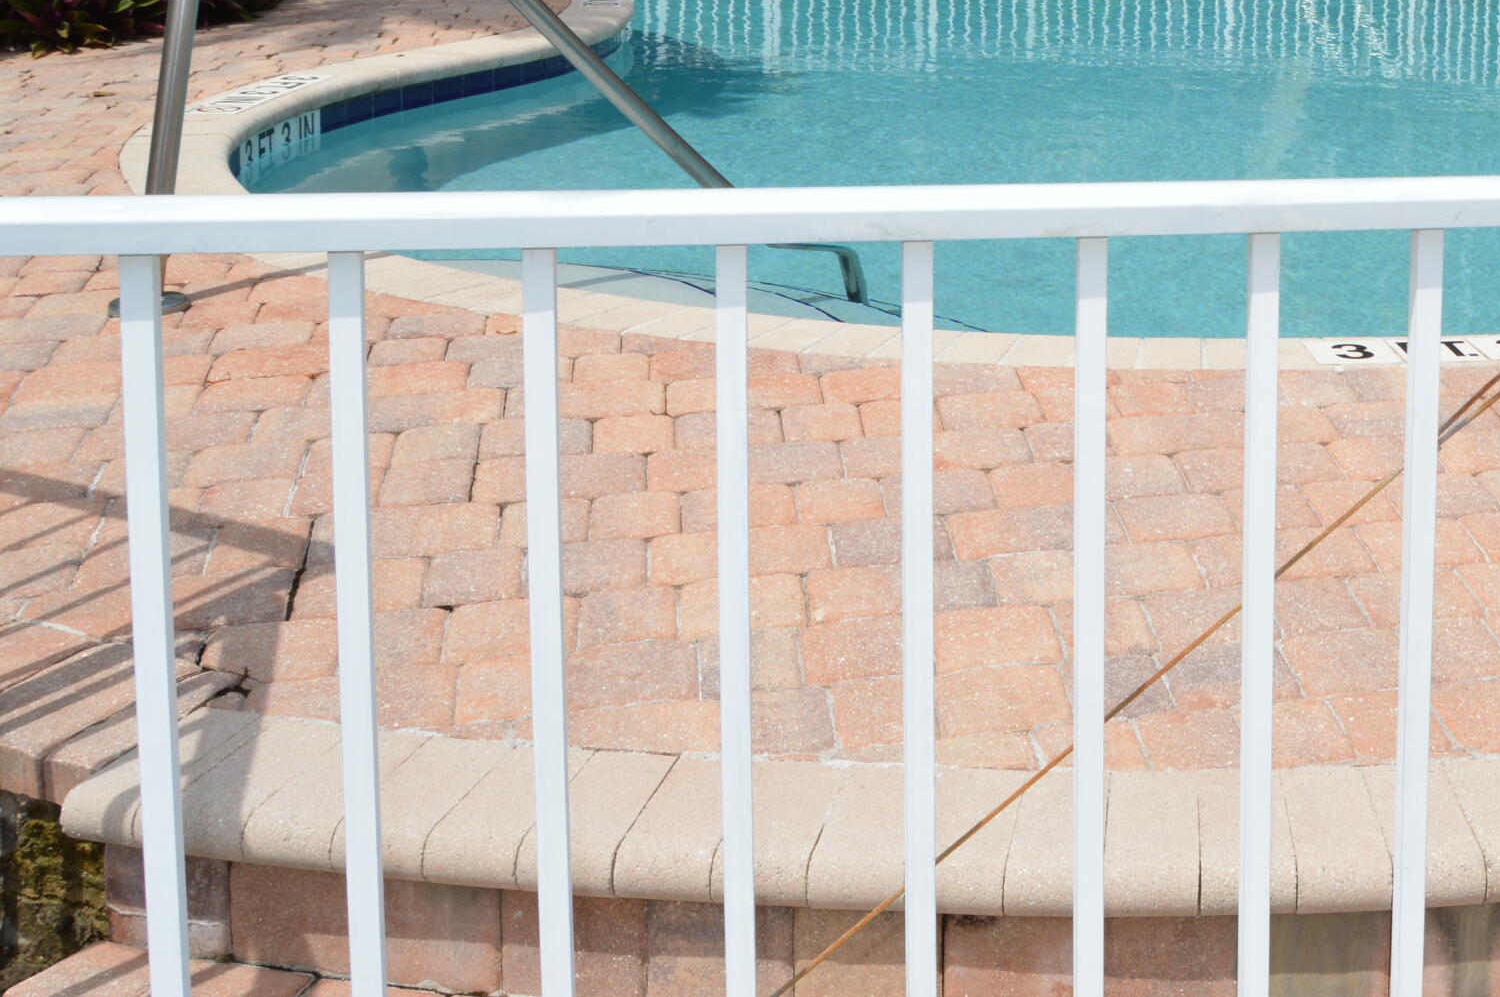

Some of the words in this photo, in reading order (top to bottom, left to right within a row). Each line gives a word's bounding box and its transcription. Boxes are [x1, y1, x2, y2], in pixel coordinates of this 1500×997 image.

[258, 127, 275, 158] FT
[297, 112, 315, 140] IN
[1331, 343, 1375, 360] 3
